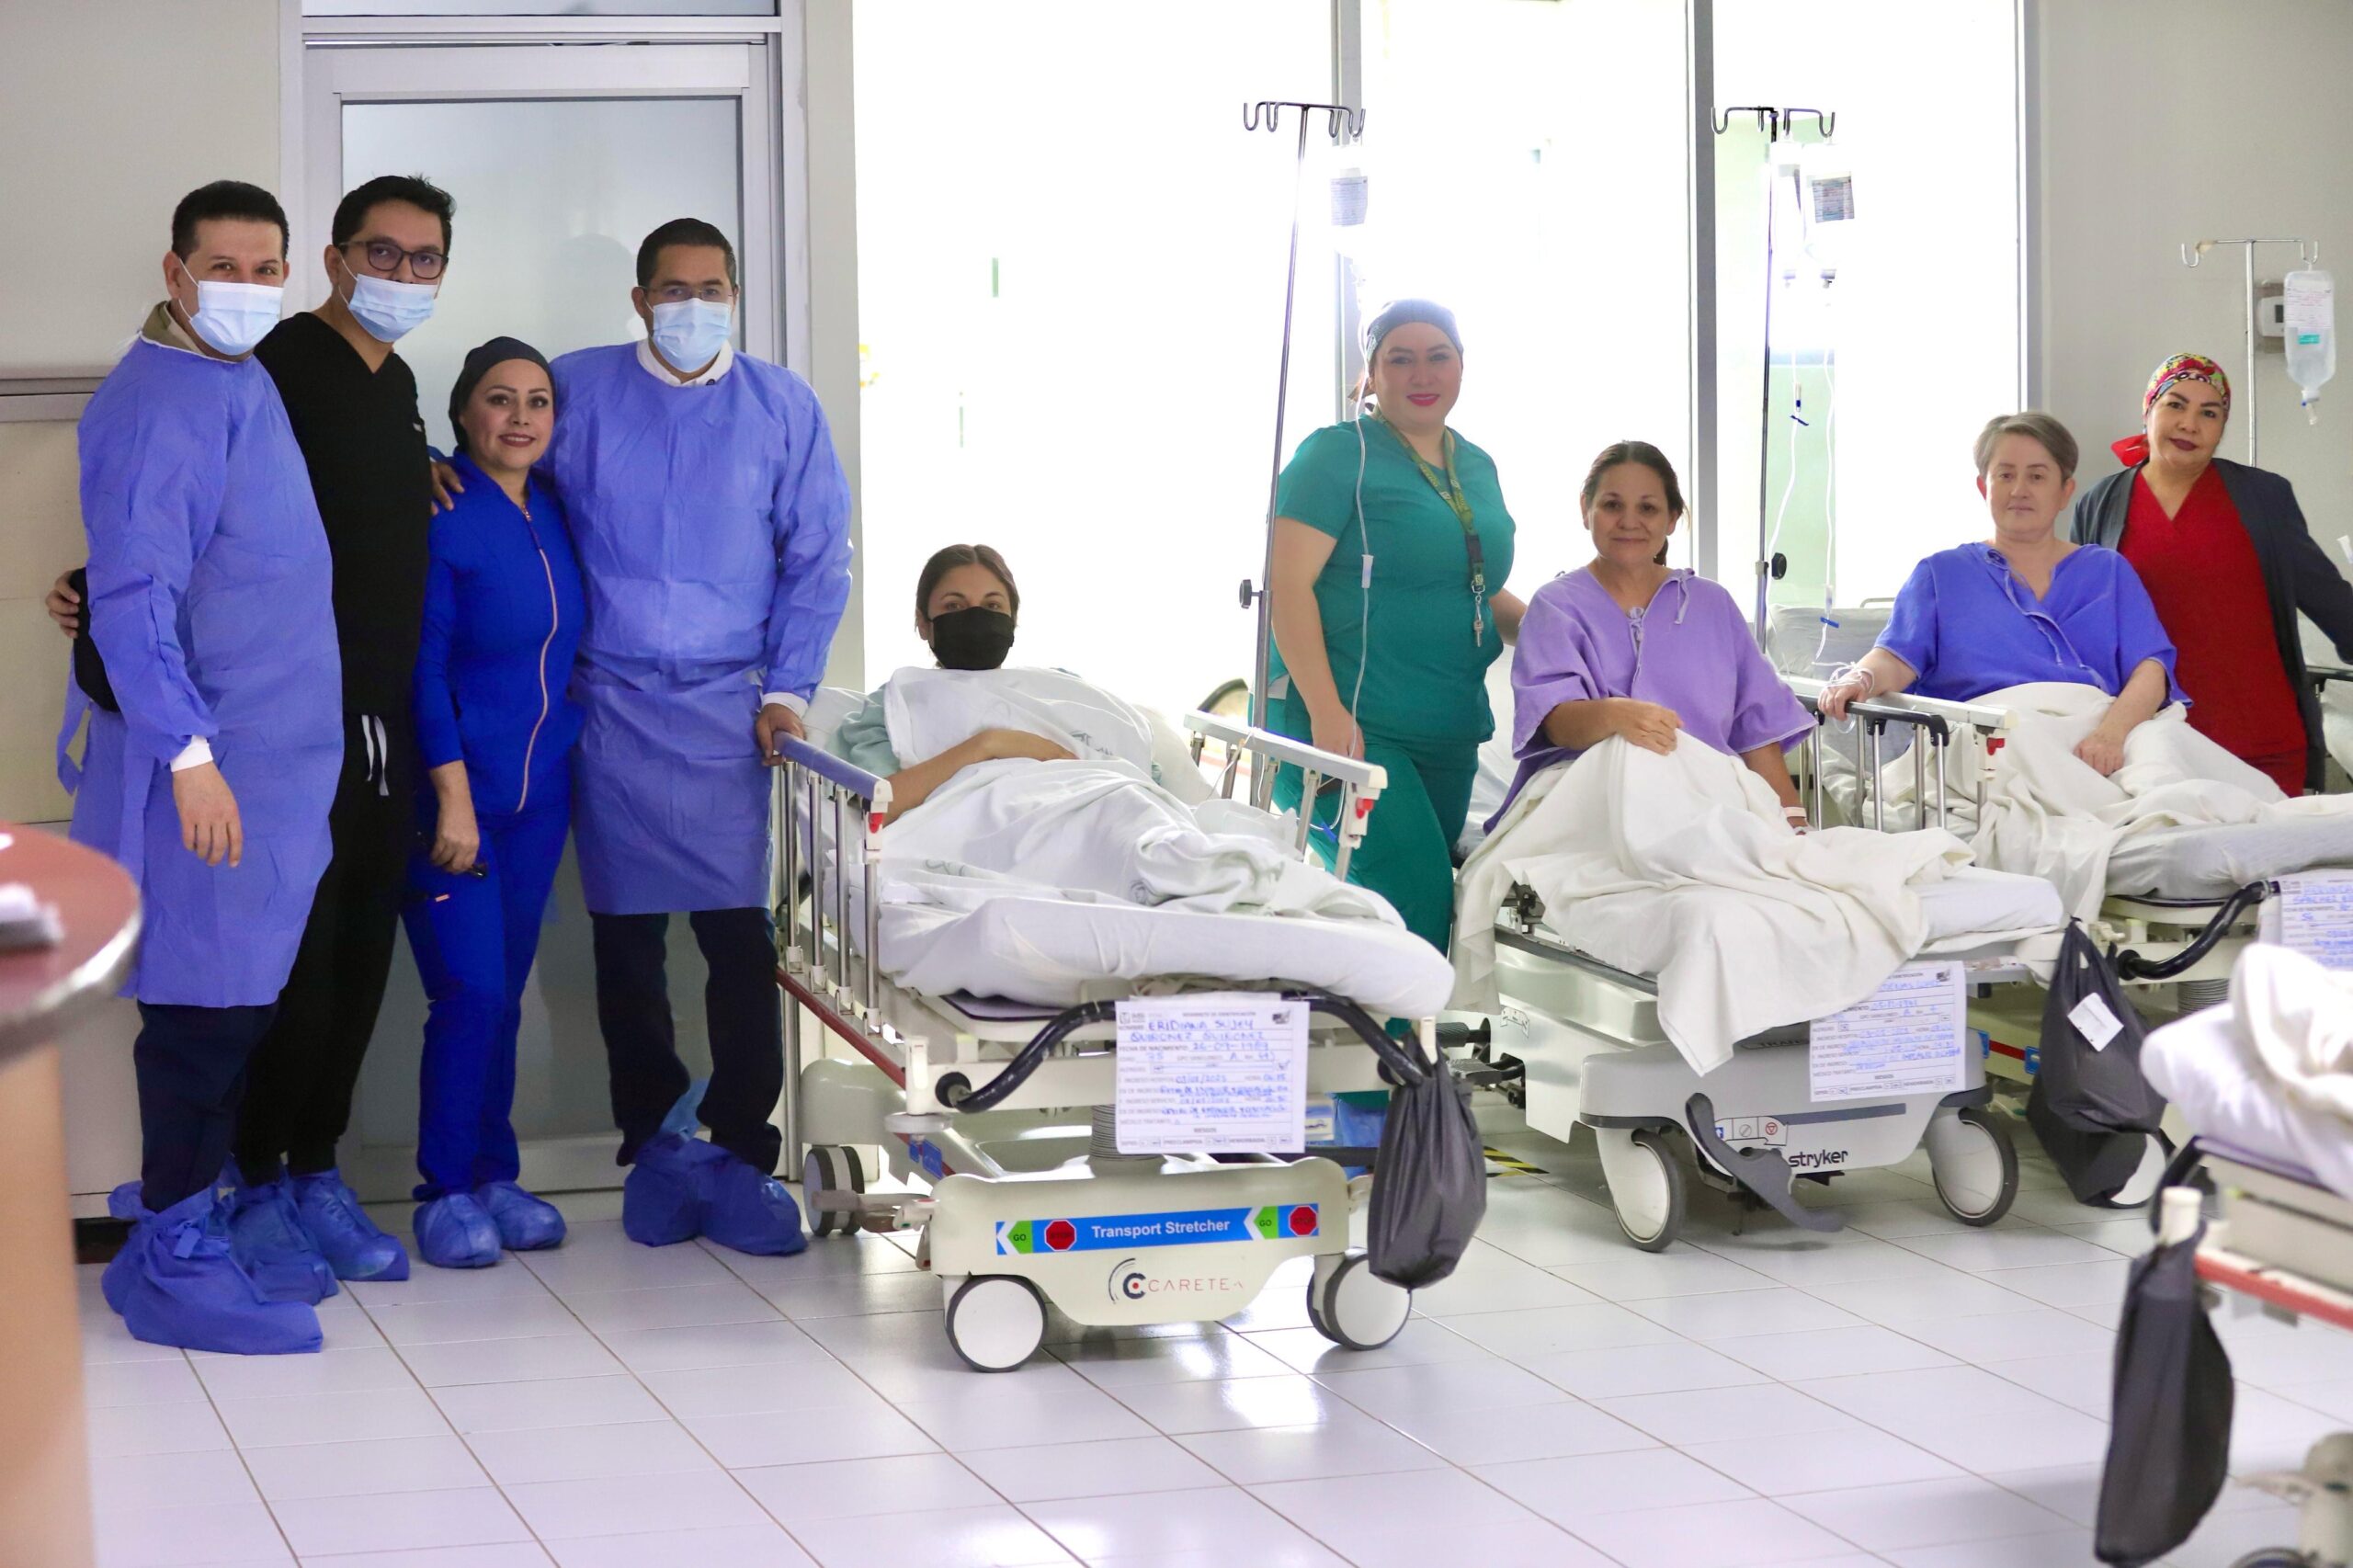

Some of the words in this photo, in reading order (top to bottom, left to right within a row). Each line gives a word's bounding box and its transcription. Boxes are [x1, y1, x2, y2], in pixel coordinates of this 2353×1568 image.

[1789, 1150, 1848, 1168] stryker
[1013, 1233, 1027, 1242] GO
[1091, 1224, 1162, 1239] Transport
[1165, 1220, 1231, 1234] Stretcher
